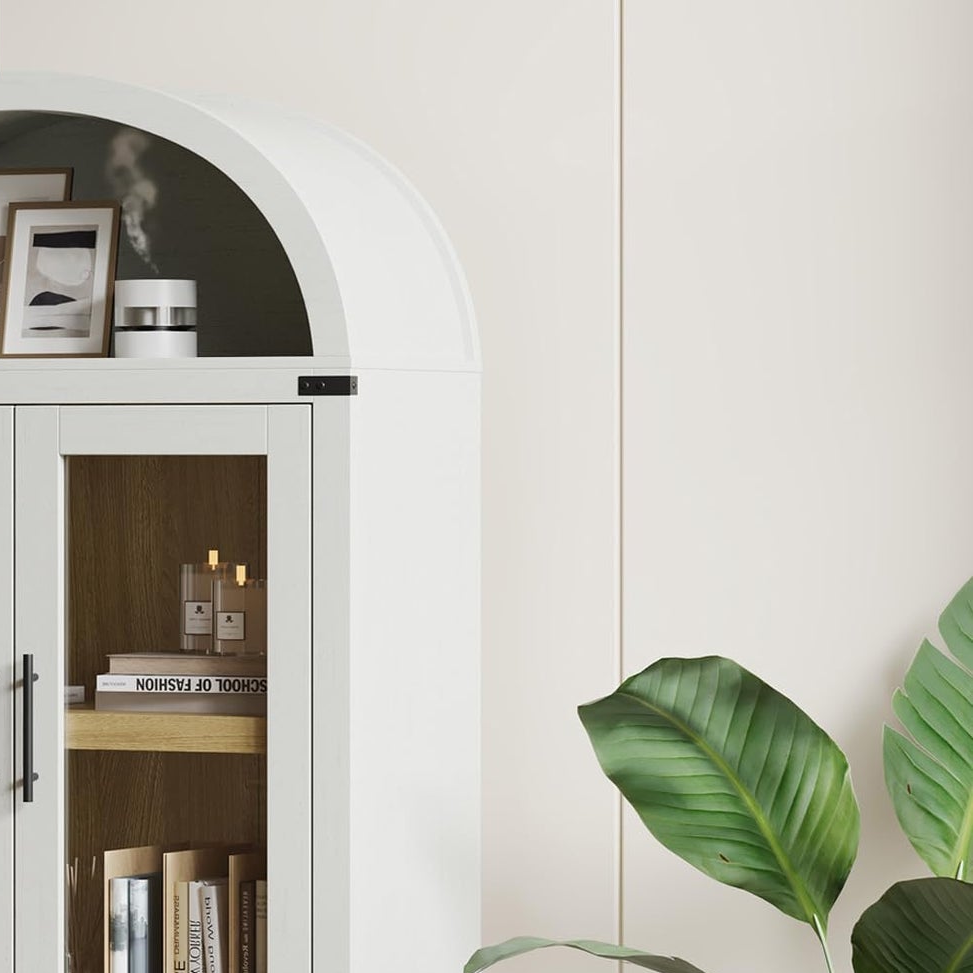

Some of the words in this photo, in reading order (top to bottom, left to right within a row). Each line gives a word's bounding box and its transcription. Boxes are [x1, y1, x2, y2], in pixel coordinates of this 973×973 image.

[136, 678, 191, 691] FASHION
[195, 678, 212, 692] OF
[216, 678, 267, 692] SCHOOL
